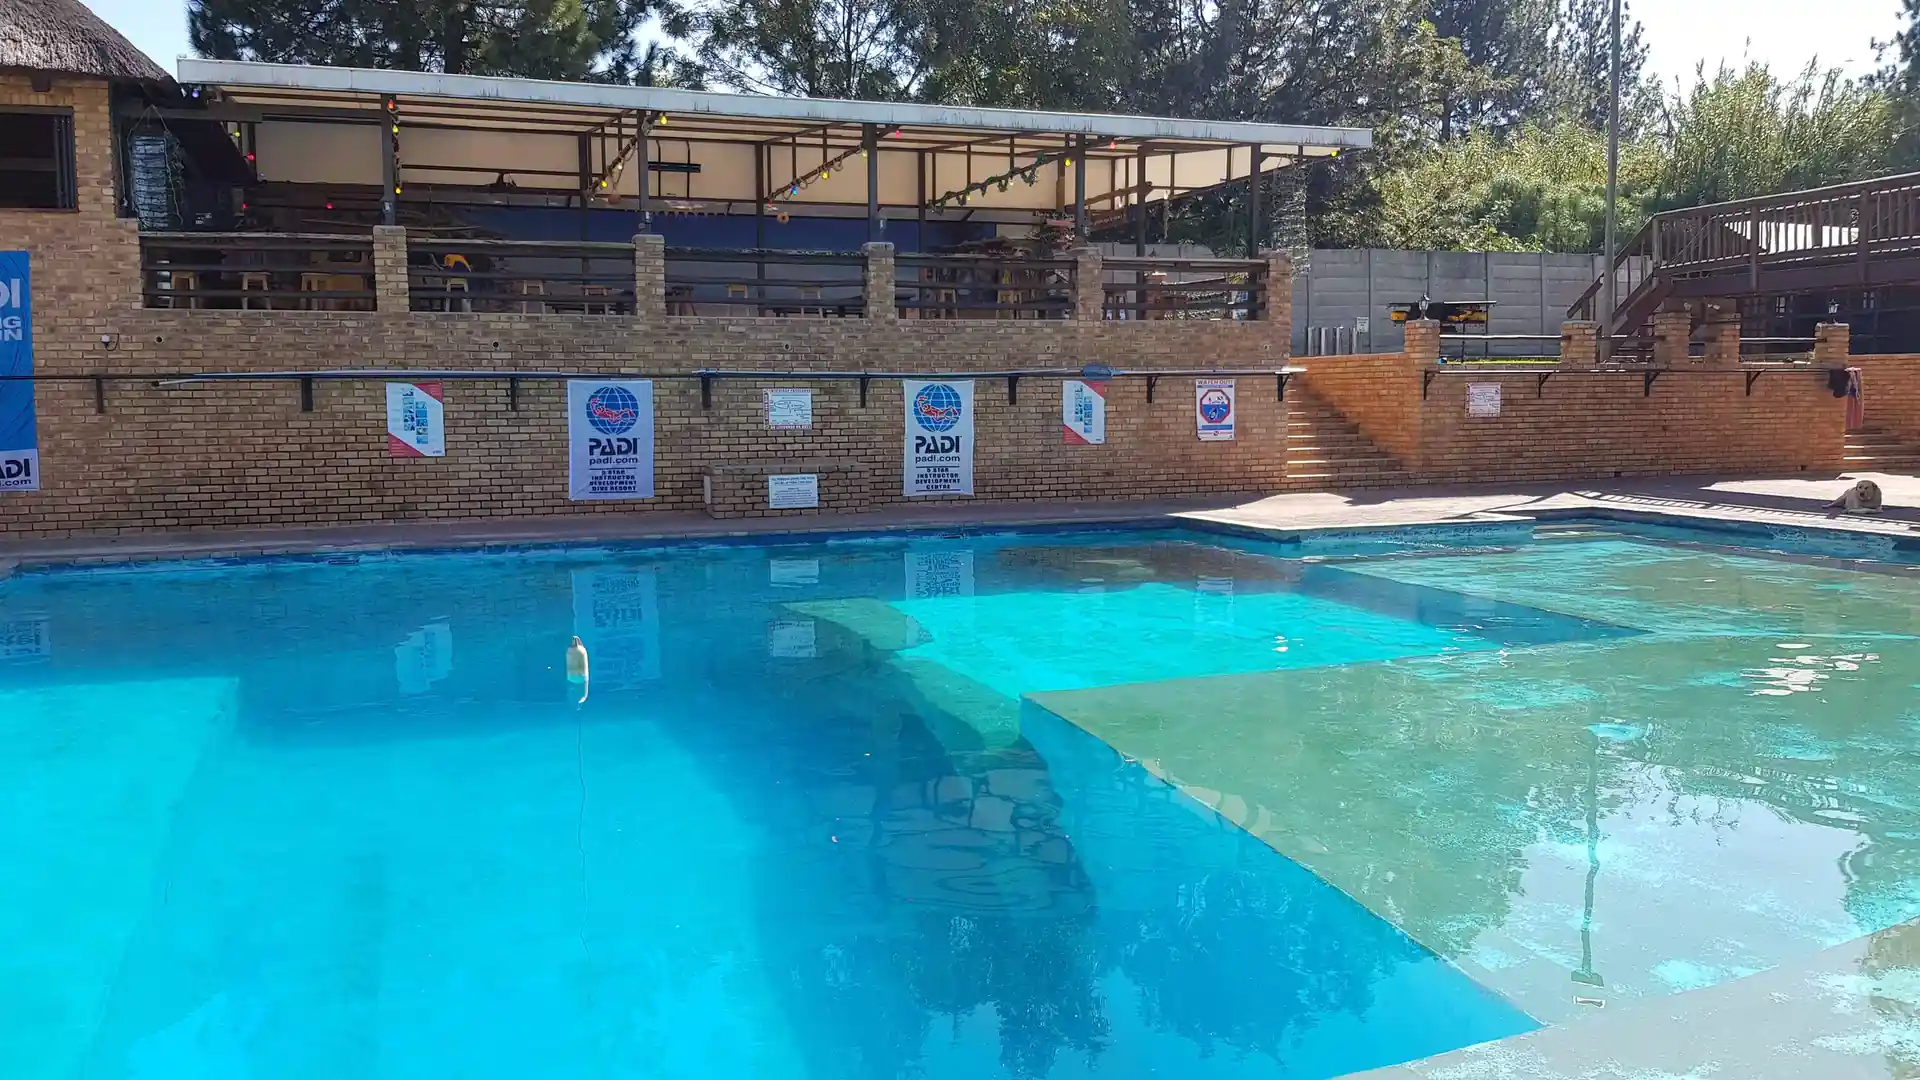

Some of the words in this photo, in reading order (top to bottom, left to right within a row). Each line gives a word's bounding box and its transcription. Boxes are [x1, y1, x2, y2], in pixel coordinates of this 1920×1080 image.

[588, 437, 638, 456] PADI
[914, 435, 960, 454] PADI
[589, 457, 638, 466] padi.com
[915, 455, 960, 464] padi.com
